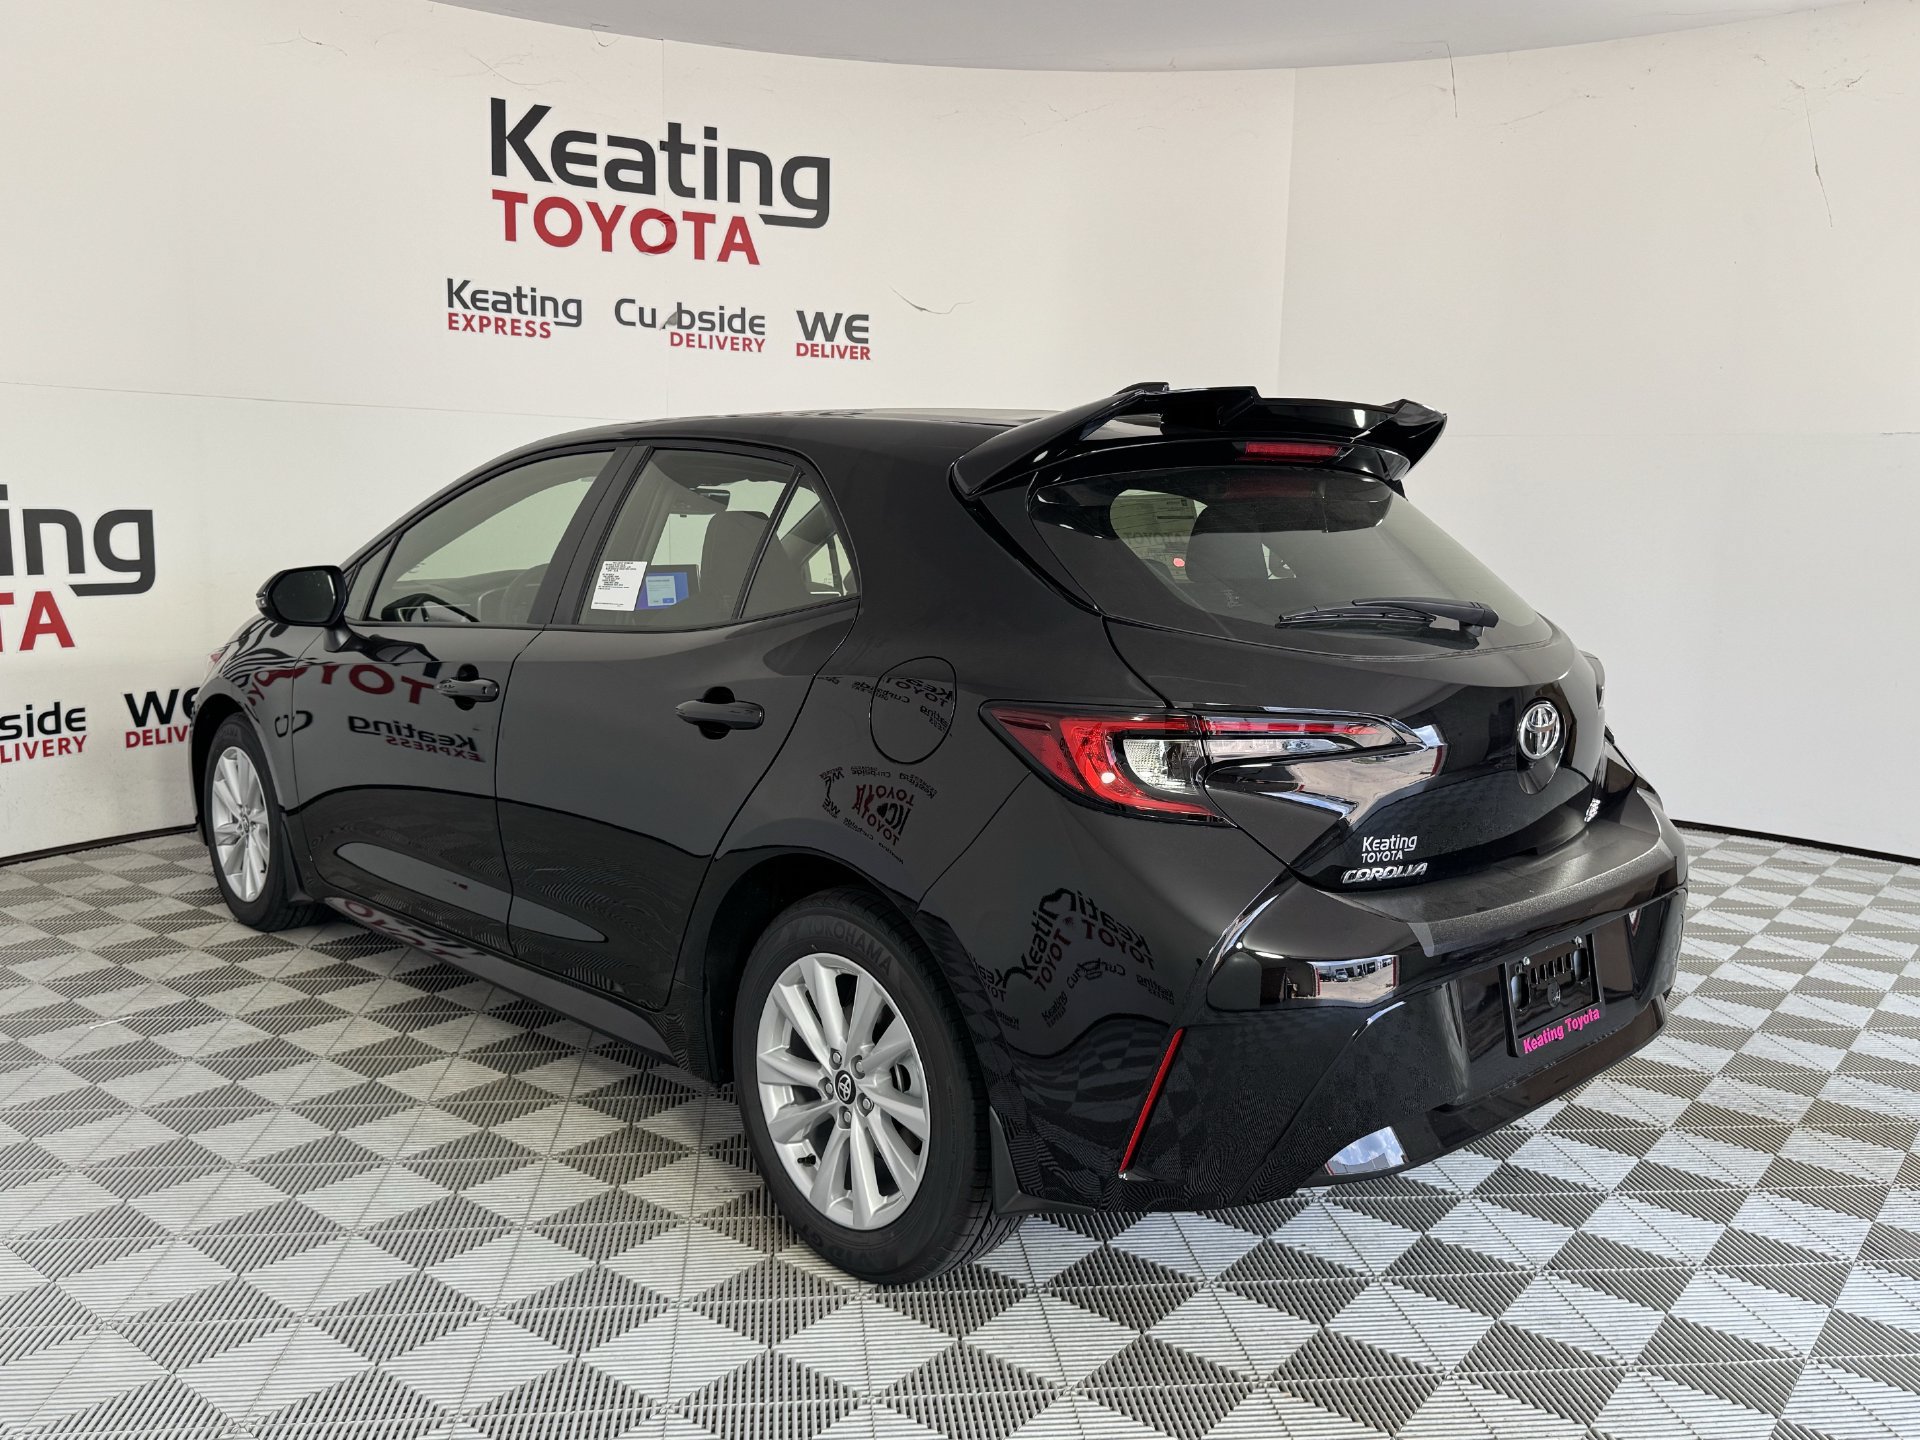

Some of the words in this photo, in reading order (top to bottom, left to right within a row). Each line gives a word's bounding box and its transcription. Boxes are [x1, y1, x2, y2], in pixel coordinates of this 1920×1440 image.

[490, 97, 831, 229] Keating
[492, 189, 760, 265] TOYOTA
[447, 278, 582, 328] Keating
[614, 298, 766, 335] Cubside
[447, 312, 552, 339] EXPRESS
[796, 310, 869, 344] WE
[670, 331, 766, 353] DELIVERY
[796, 342, 871, 361] DELIVER
[125, 725, 190, 749] DELIV
[1362, 834, 1418, 852] Keating
[1361, 850, 1404, 864] TOYOTA
[1341, 862, 1428, 884] COROLLA
[1523, 1025, 1565, 1054] Keating
[1565, 1008, 1600, 1032] Toyota
